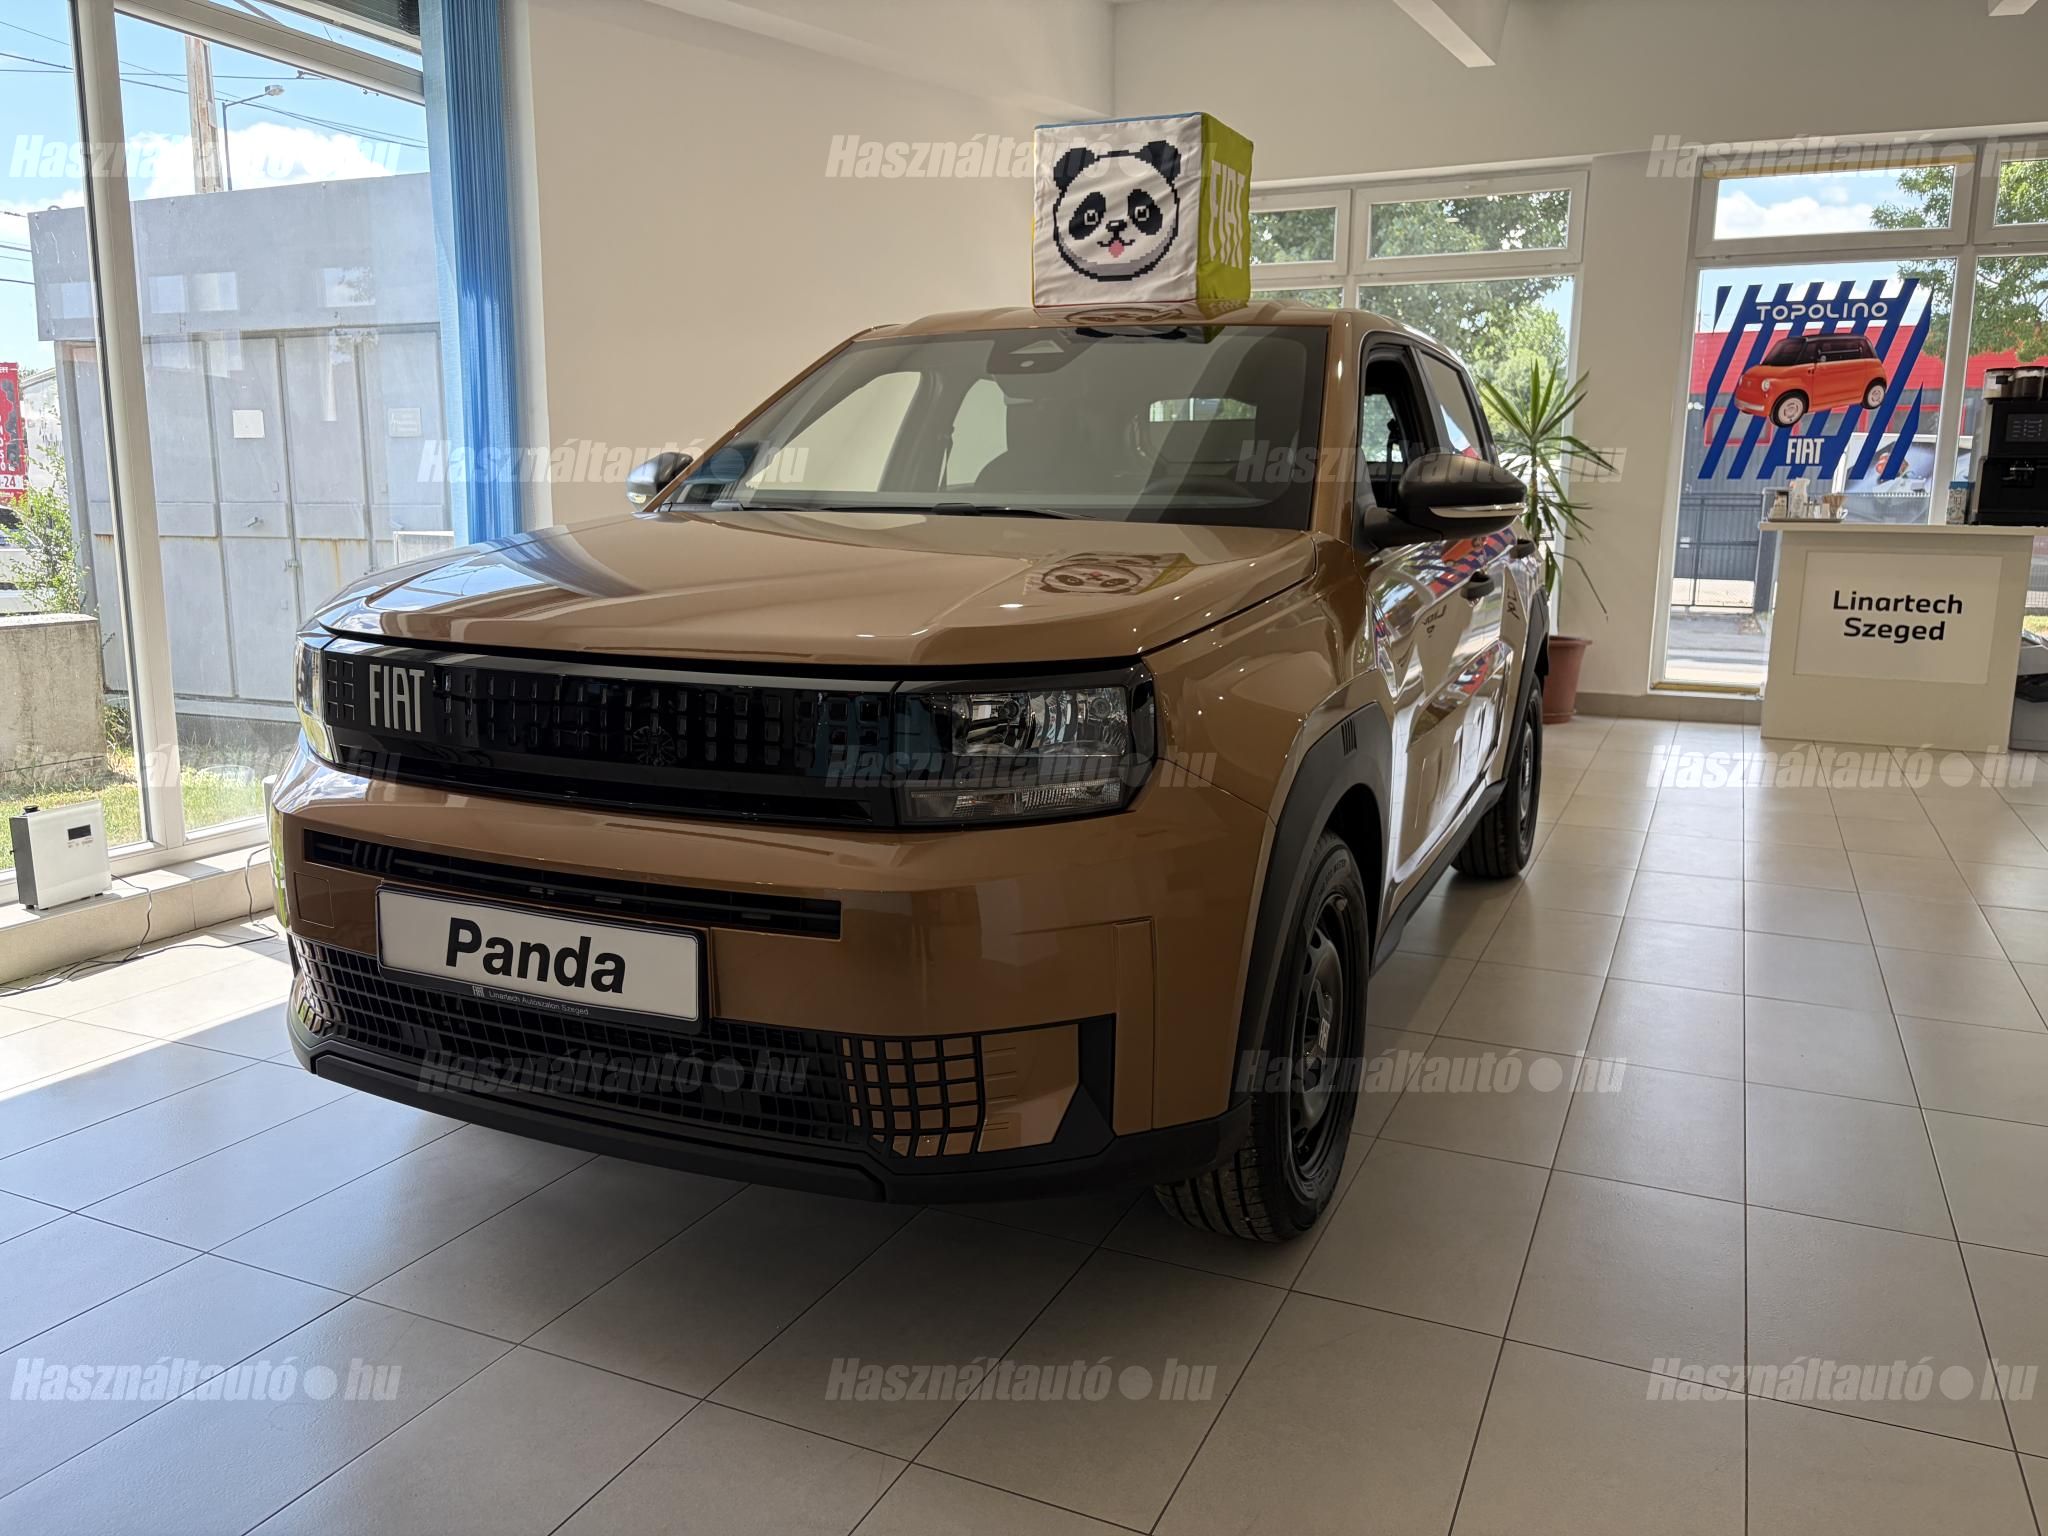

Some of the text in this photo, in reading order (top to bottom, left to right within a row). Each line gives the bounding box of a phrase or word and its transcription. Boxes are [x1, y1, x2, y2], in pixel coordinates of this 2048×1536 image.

[1208, 160, 1245, 270] FIAT
[1756, 302, 1888, 321] TOPOLINO
[1786, 438, 1825, 465] FIAT
[1833, 590, 1963, 615] Linartech
[1843, 617, 1946, 643] Szeged
[369, 664, 425, 733] FIAT
[445, 916, 627, 995] Panda
